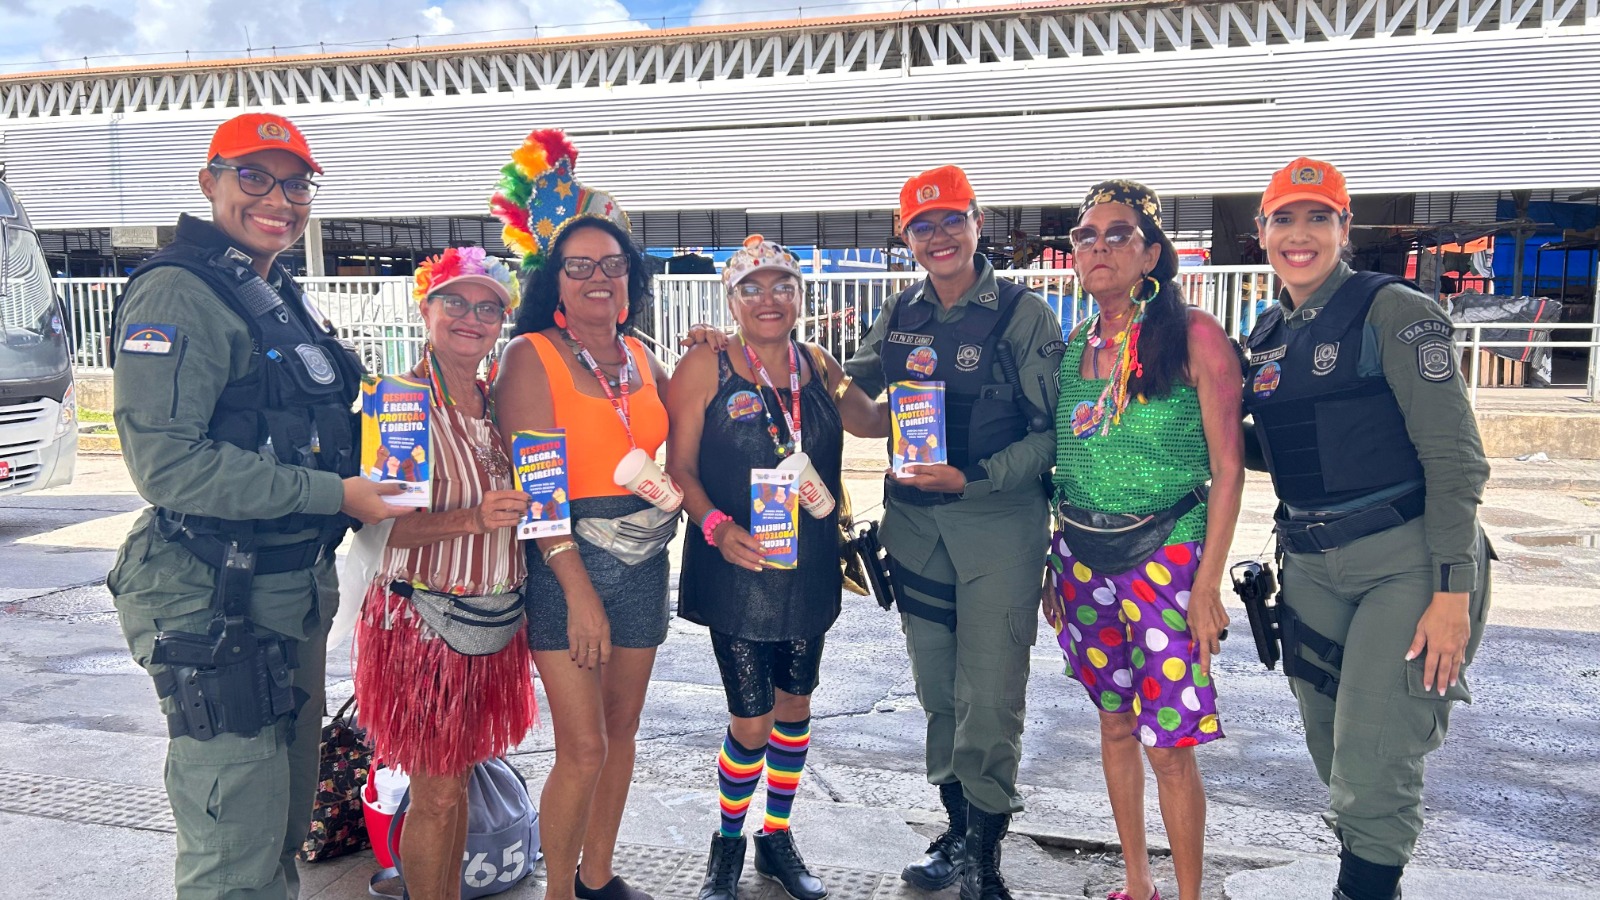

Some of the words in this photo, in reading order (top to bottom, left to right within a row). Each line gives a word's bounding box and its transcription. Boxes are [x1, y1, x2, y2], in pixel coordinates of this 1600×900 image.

[1404, 322, 1450, 340] DASDH
[382, 393, 424, 402] RESPEITO
[898, 393, 933, 405] RESPEITO
[383, 402, 389, 412] É
[390, 402, 422, 413] REGRA,
[900, 404, 905, 413] É
[905, 401, 933, 411] REGRA,
[379, 411, 426, 423] PROTEÇÃO
[897, 407, 936, 420] PROTEÇÃO
[381, 422, 387, 433] É
[388, 422, 426, 432] DIREITO.
[900, 419, 905, 428] É
[905, 416, 936, 426] DIREITO.
[519, 441, 561, 456] RESPEITO
[521, 455, 527, 465] É
[528, 450, 560, 463] REGRA,
[518, 457, 564, 475] PROTEÇÃO
[521, 473, 527, 483] É
[528, 466, 564, 481] DIREITO.
[753, 522, 786, 533] DIREITO.
[787, 522, 792, 531] É
[785, 538, 791, 547] É
